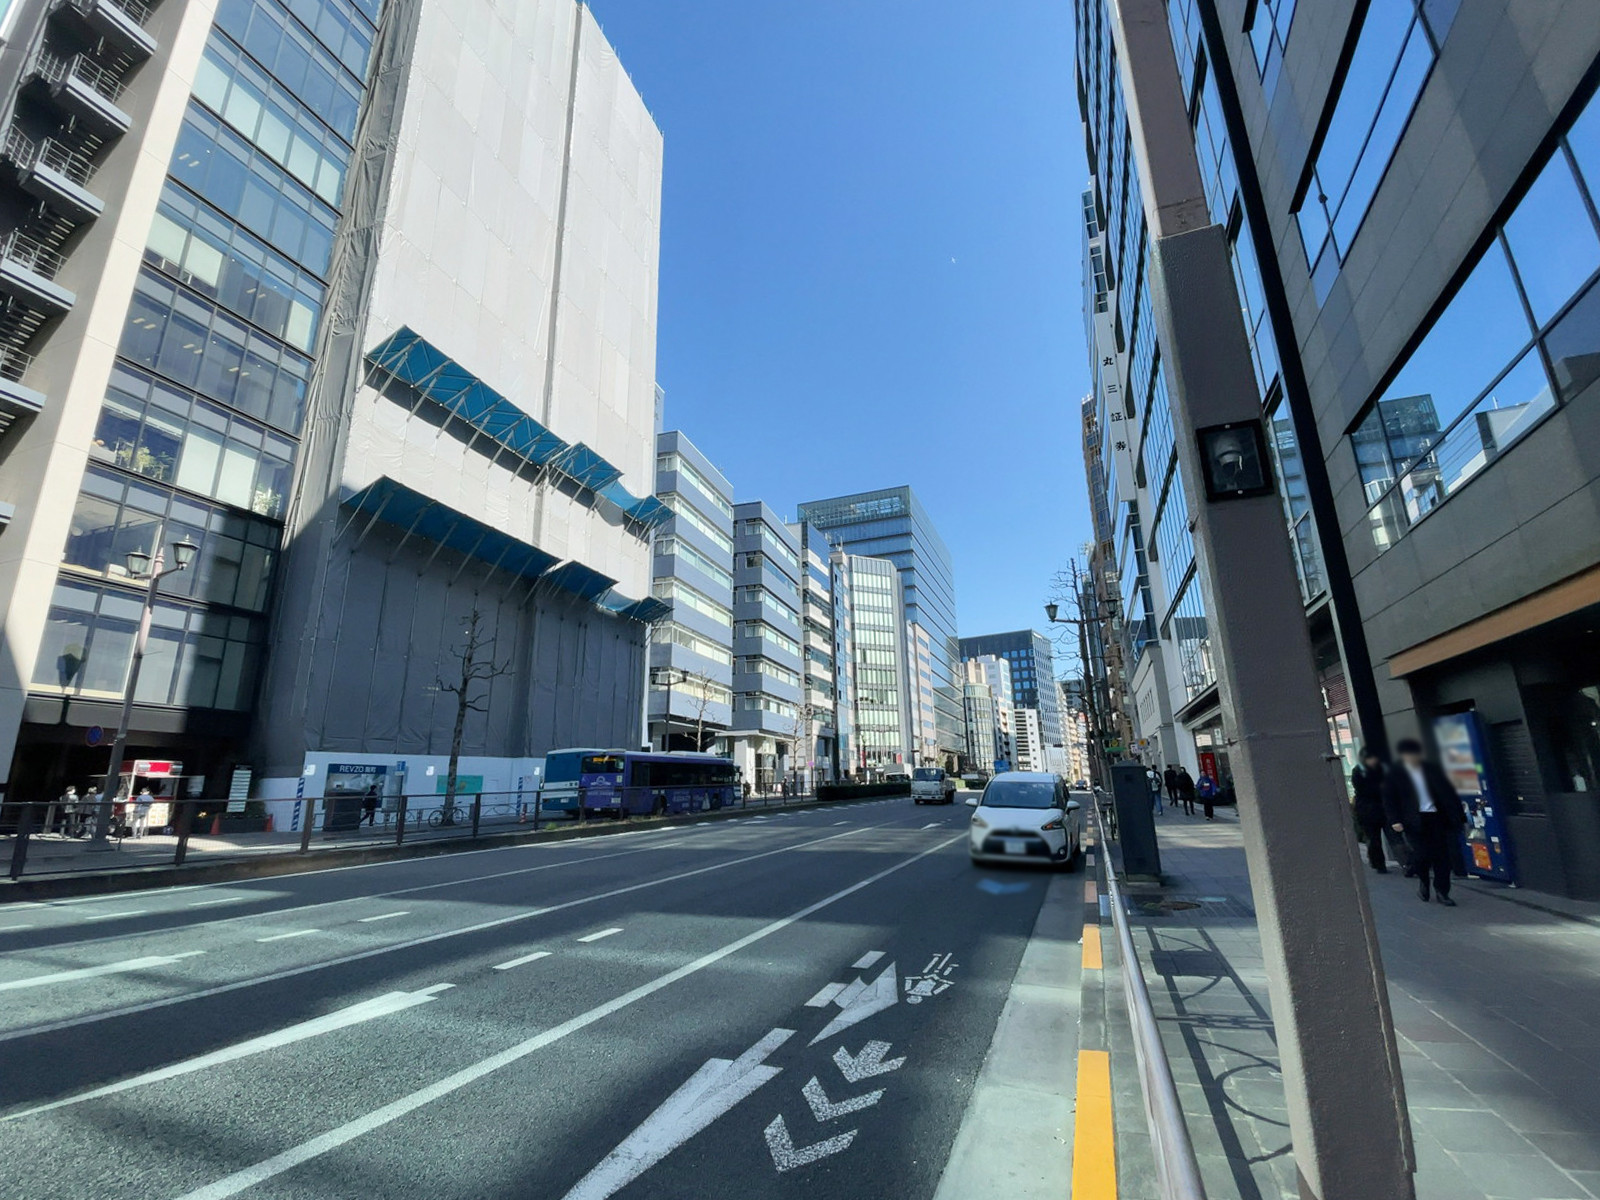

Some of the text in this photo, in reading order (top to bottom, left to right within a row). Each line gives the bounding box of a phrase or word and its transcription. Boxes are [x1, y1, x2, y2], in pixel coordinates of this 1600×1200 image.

[1103, 357, 1126, 451] 丸三証券
[339, 765, 364, 773] REVZO
